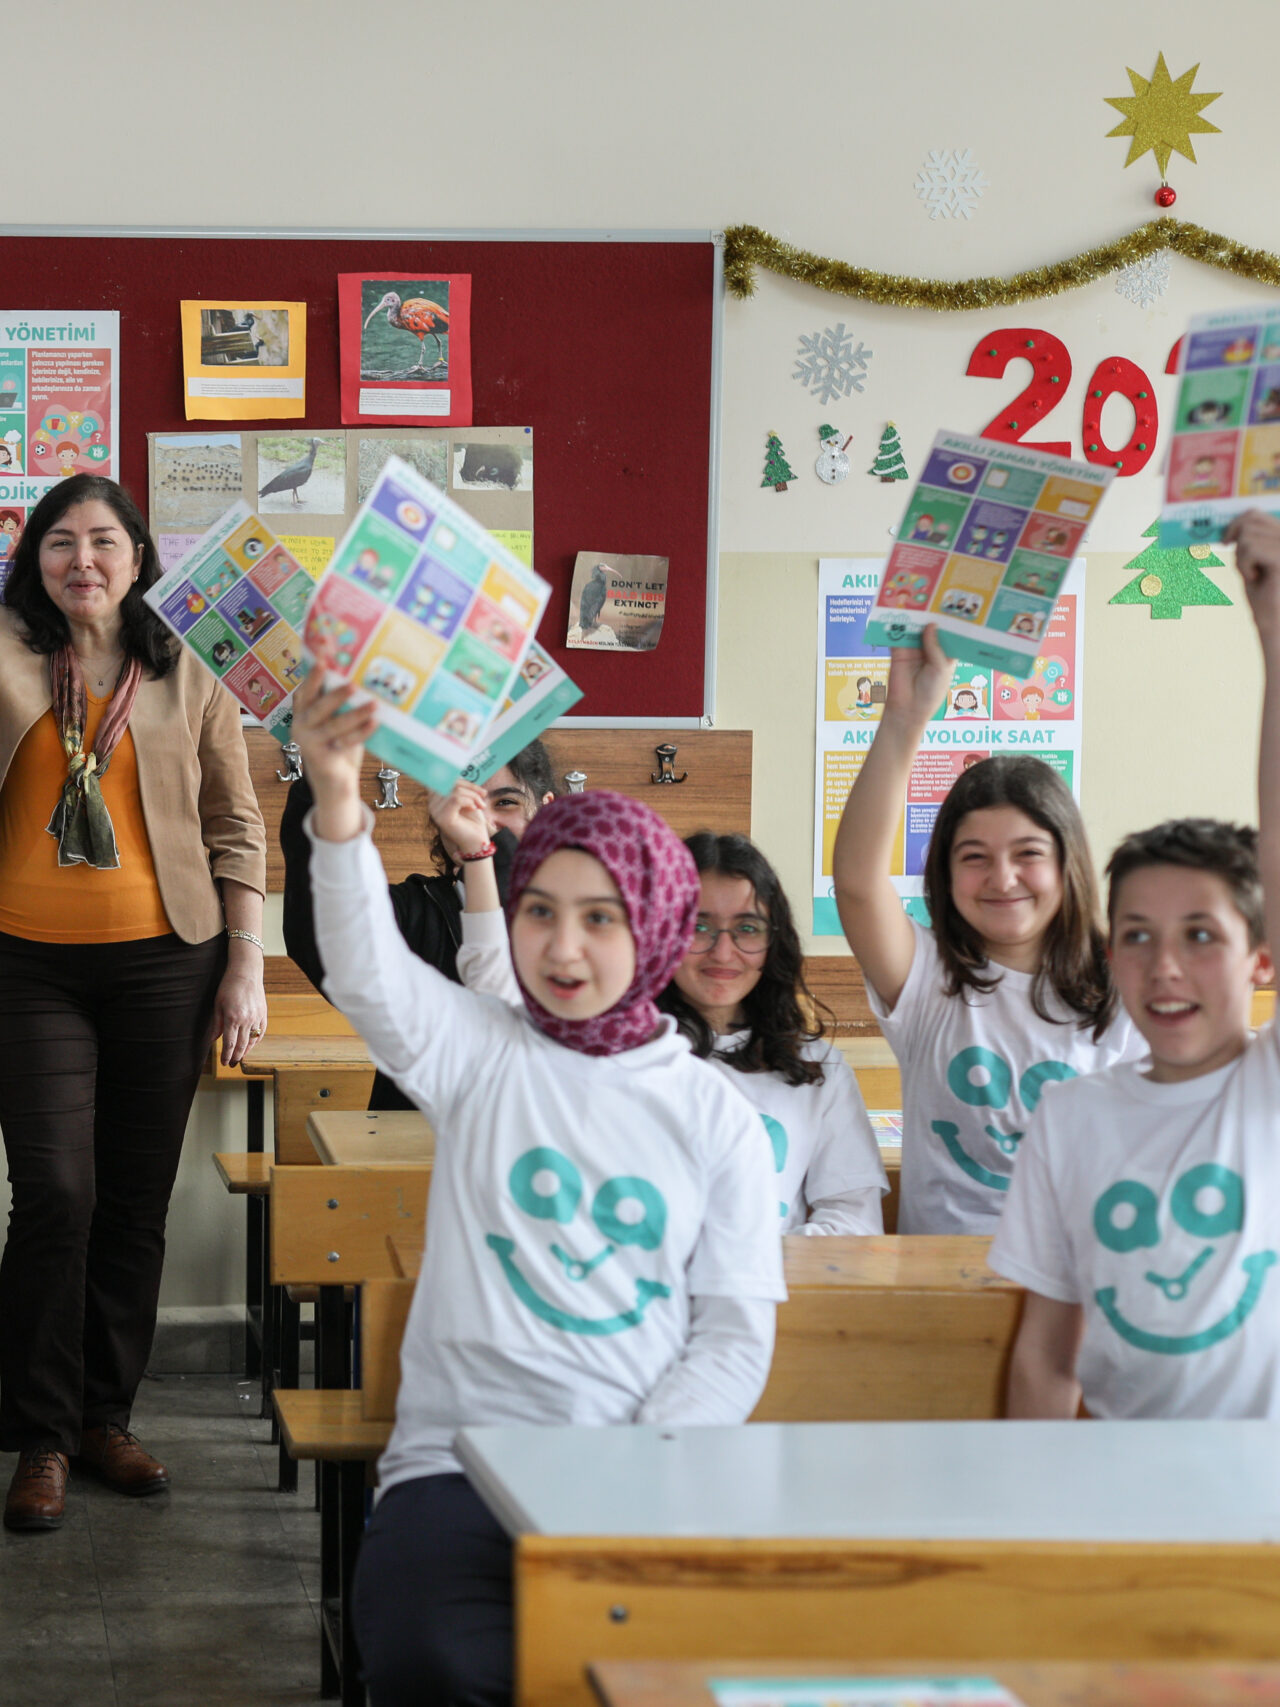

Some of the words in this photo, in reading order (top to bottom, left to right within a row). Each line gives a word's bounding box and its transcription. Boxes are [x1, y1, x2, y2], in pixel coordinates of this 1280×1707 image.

[6, 322, 96, 341] YÖNETİMİ
[611, 580, 643, 589] DON'T
[645, 582, 665, 591] LET
[614, 599, 659, 609] EXTINCT
[830, 598, 863, 607] Hedeflerinizi
[829, 615, 856, 624] belirleyin.
[1008, 729, 1056, 745] SAAT
